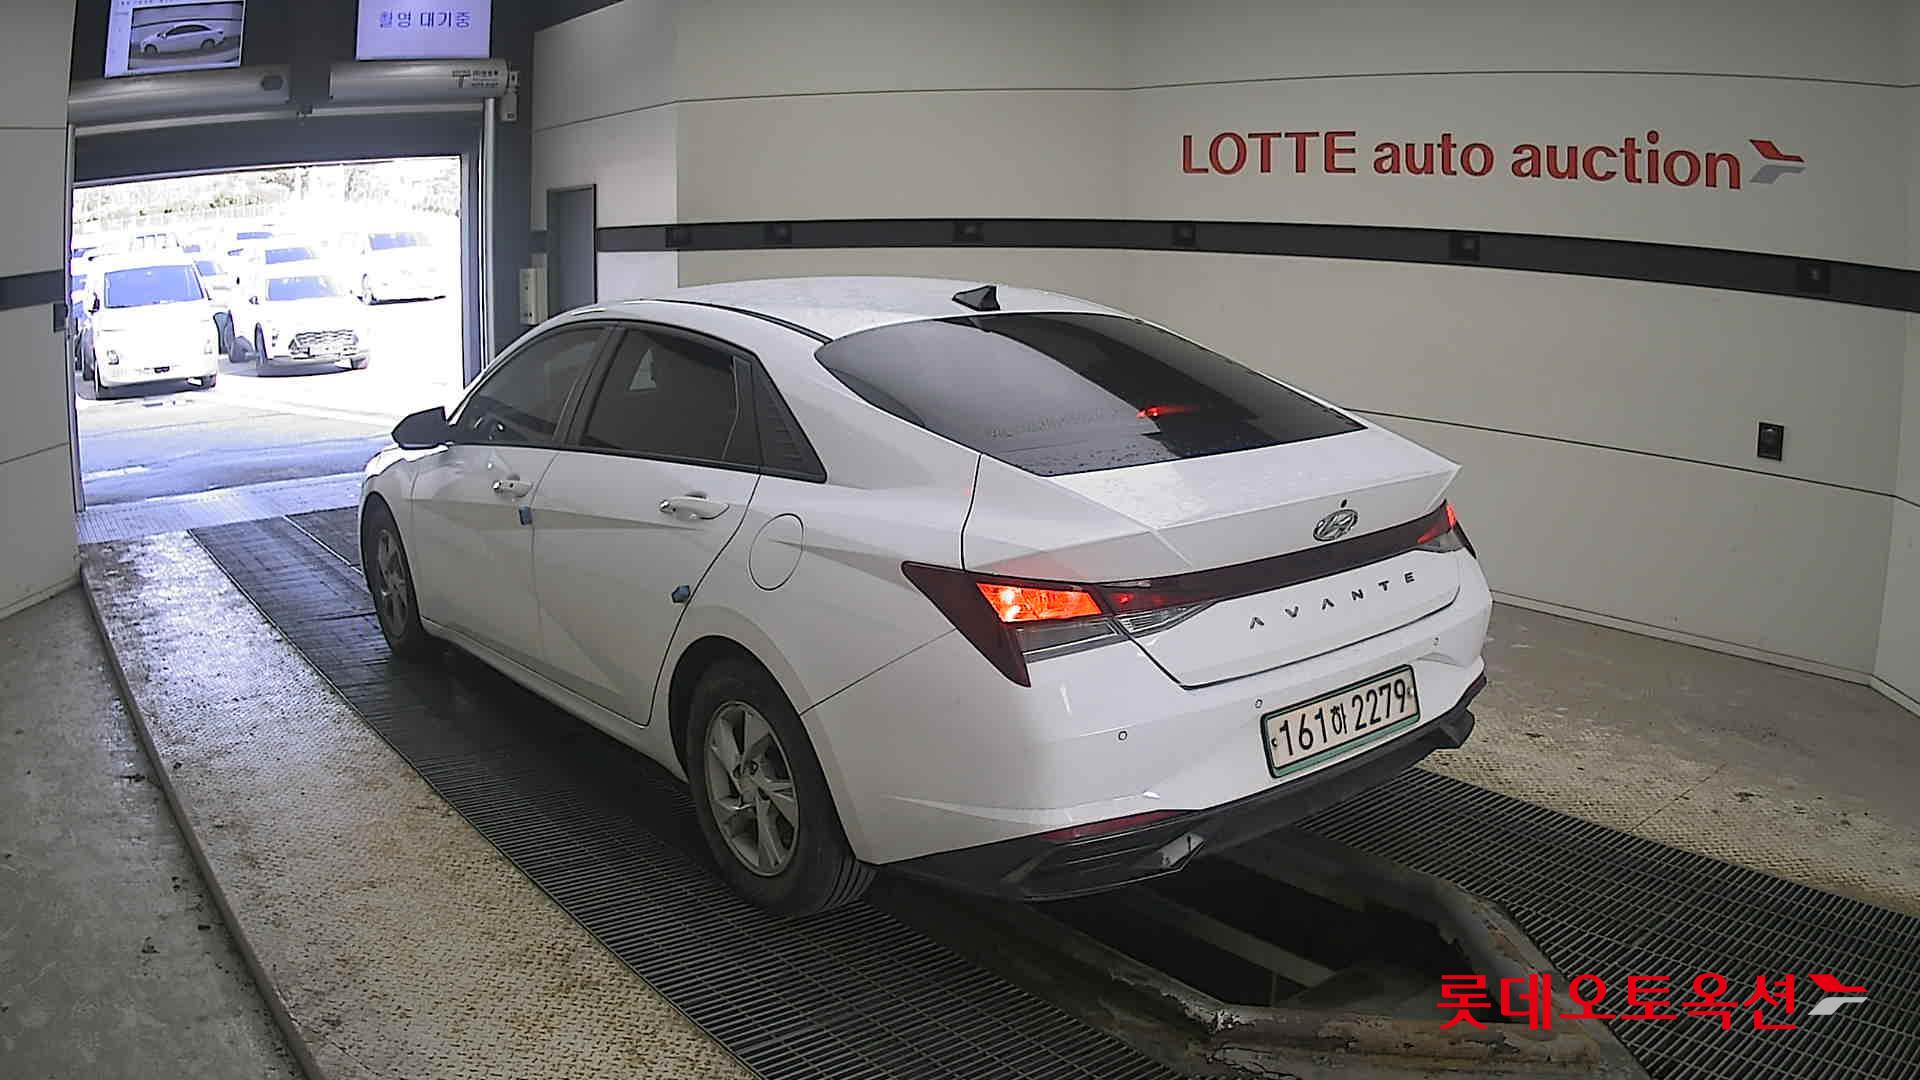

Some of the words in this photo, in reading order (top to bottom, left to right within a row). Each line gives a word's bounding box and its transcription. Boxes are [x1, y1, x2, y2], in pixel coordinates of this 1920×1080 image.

[420, 10, 471, 29] 대기중
[1182, 131, 1358, 175] LOTTE
[1373, 133, 1496, 177] auto
[1511, 130, 1742, 189] auction
[1249, 571, 1416, 629] AVANTE
